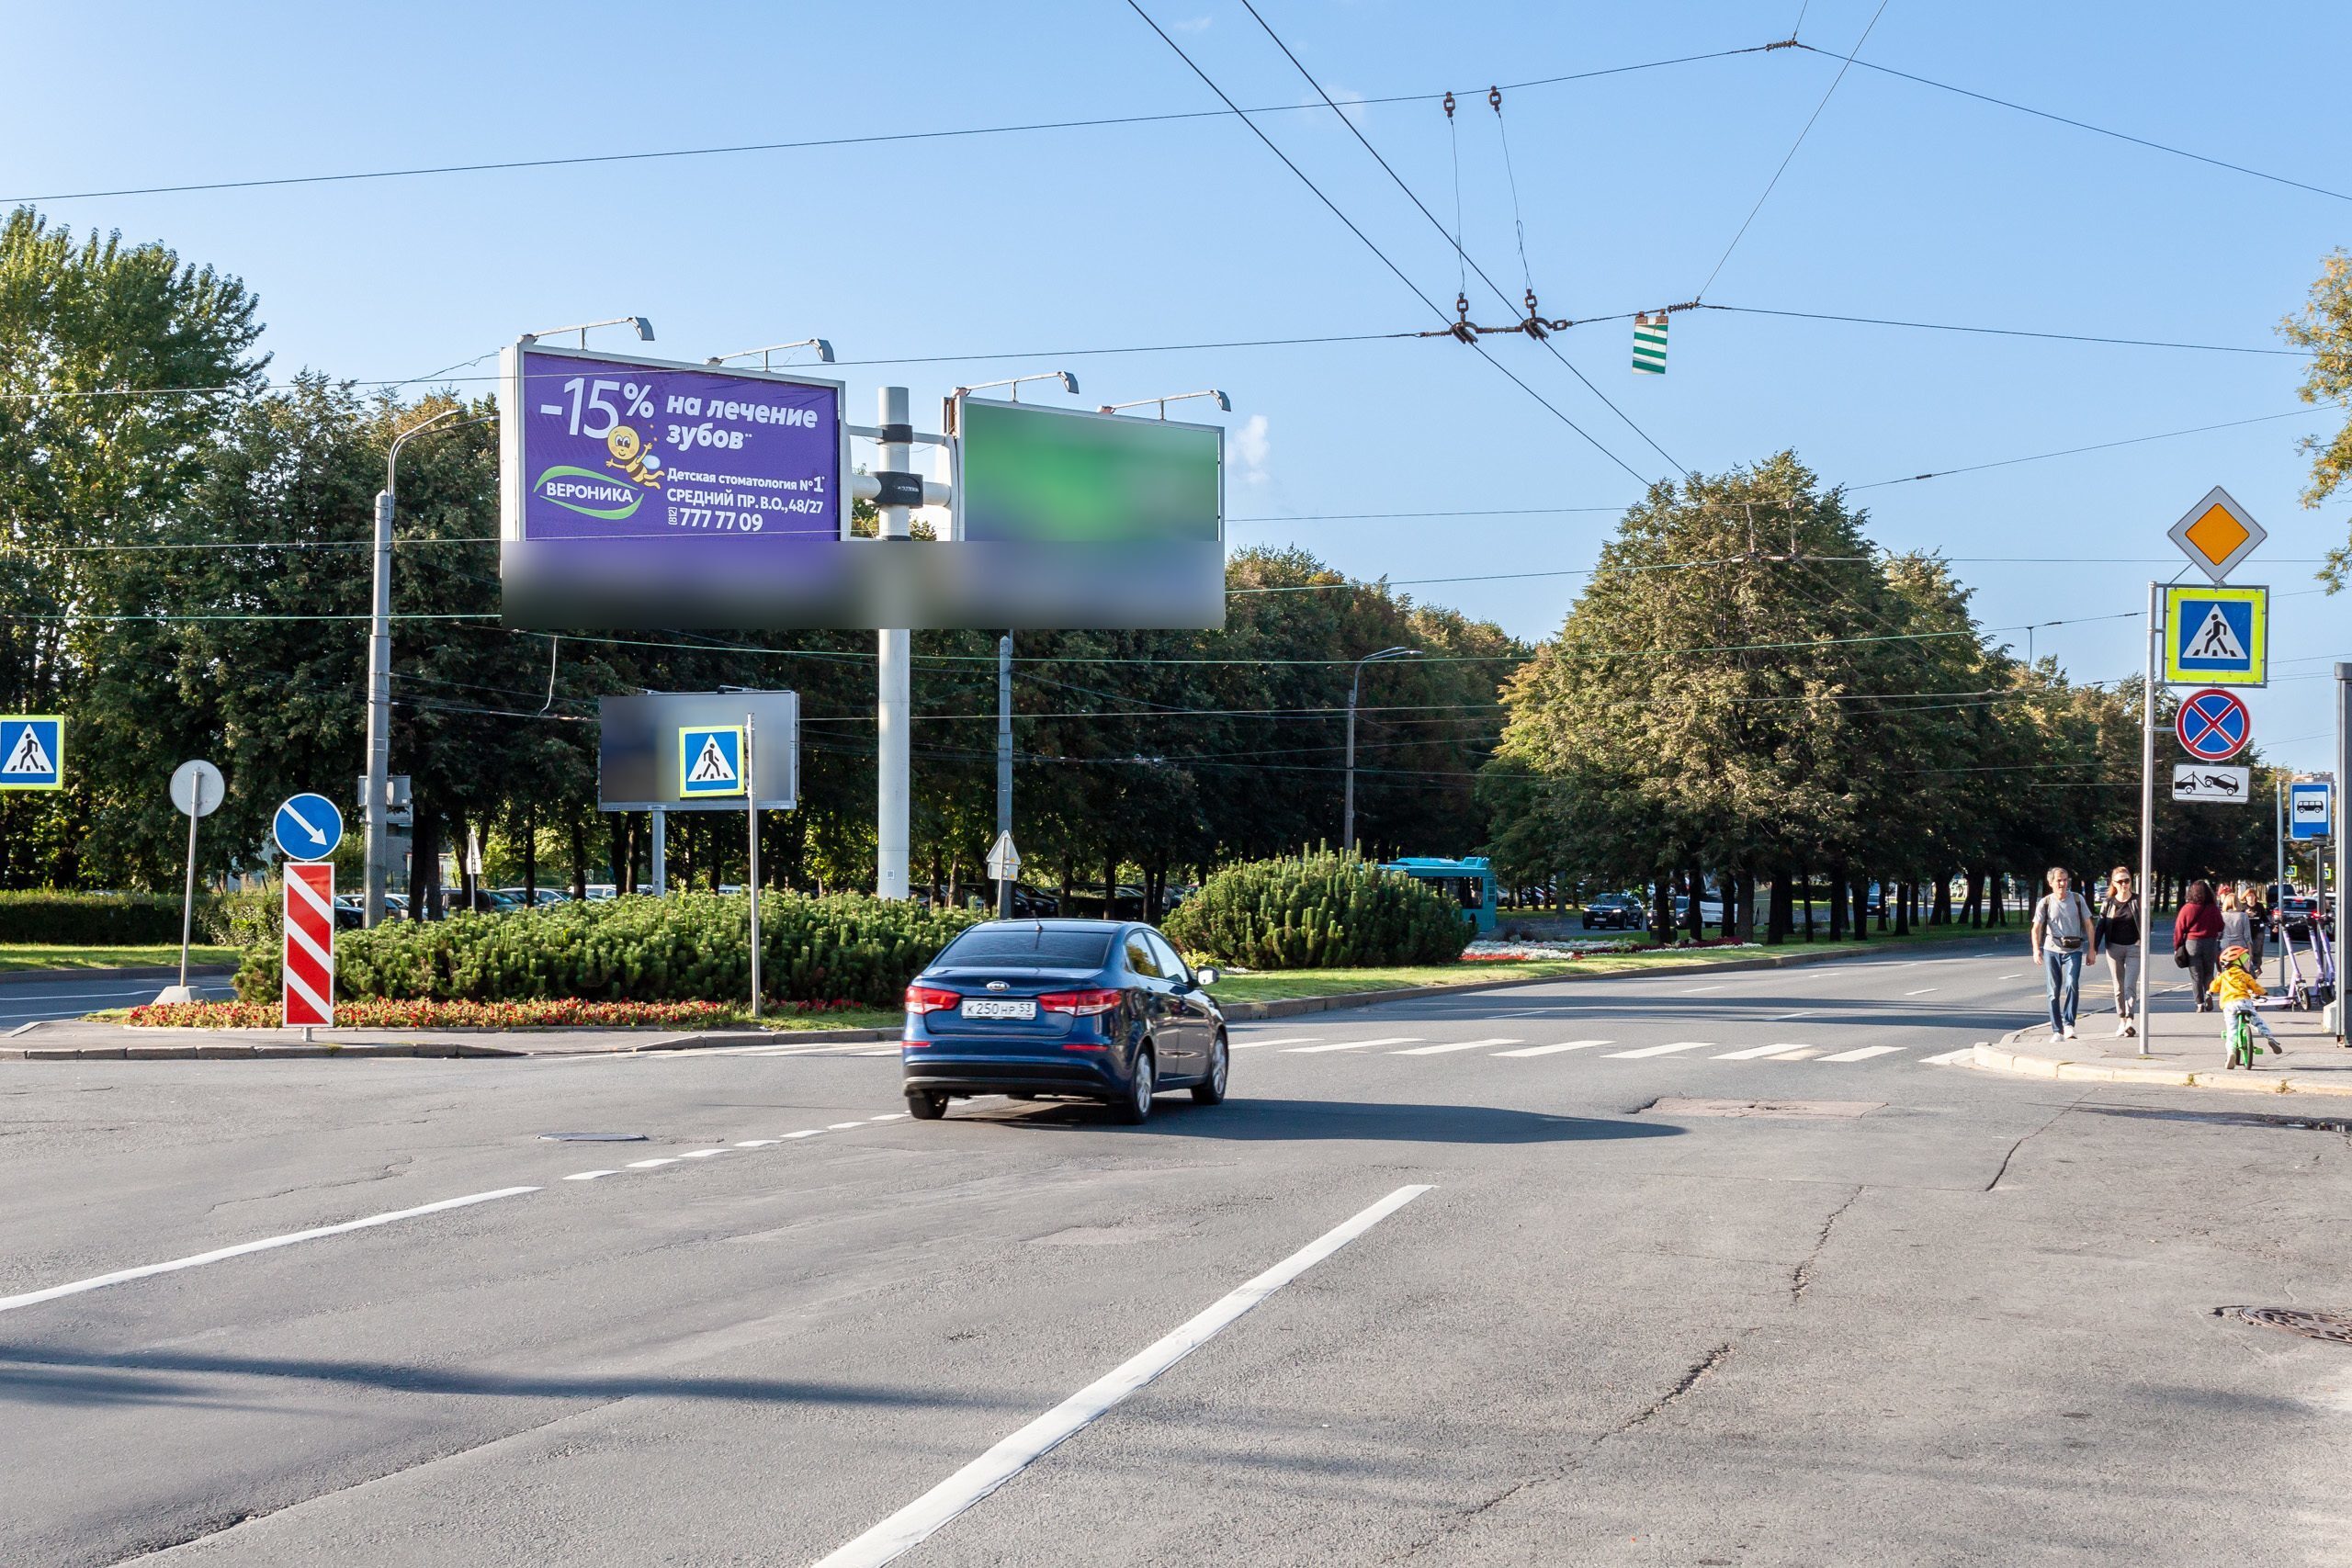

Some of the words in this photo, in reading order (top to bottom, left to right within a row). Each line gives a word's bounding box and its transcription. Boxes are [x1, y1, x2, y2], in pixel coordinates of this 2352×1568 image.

[540, 377, 655, 439] -15%
[666, 395, 702, 416] на
[707, 400, 819, 429] лечение
[666, 468, 717, 483] Детская
[718, 474, 797, 491] стоматология
[546, 481, 634, 503] ВЕРОНИКА
[666, 488, 734, 507] СРЕДНИЙ
[667, 506, 678, 525] (812)
[679, 507, 712, 528] 777
[715, 510, 737, 530] 77
[739, 512, 763, 532] 09
